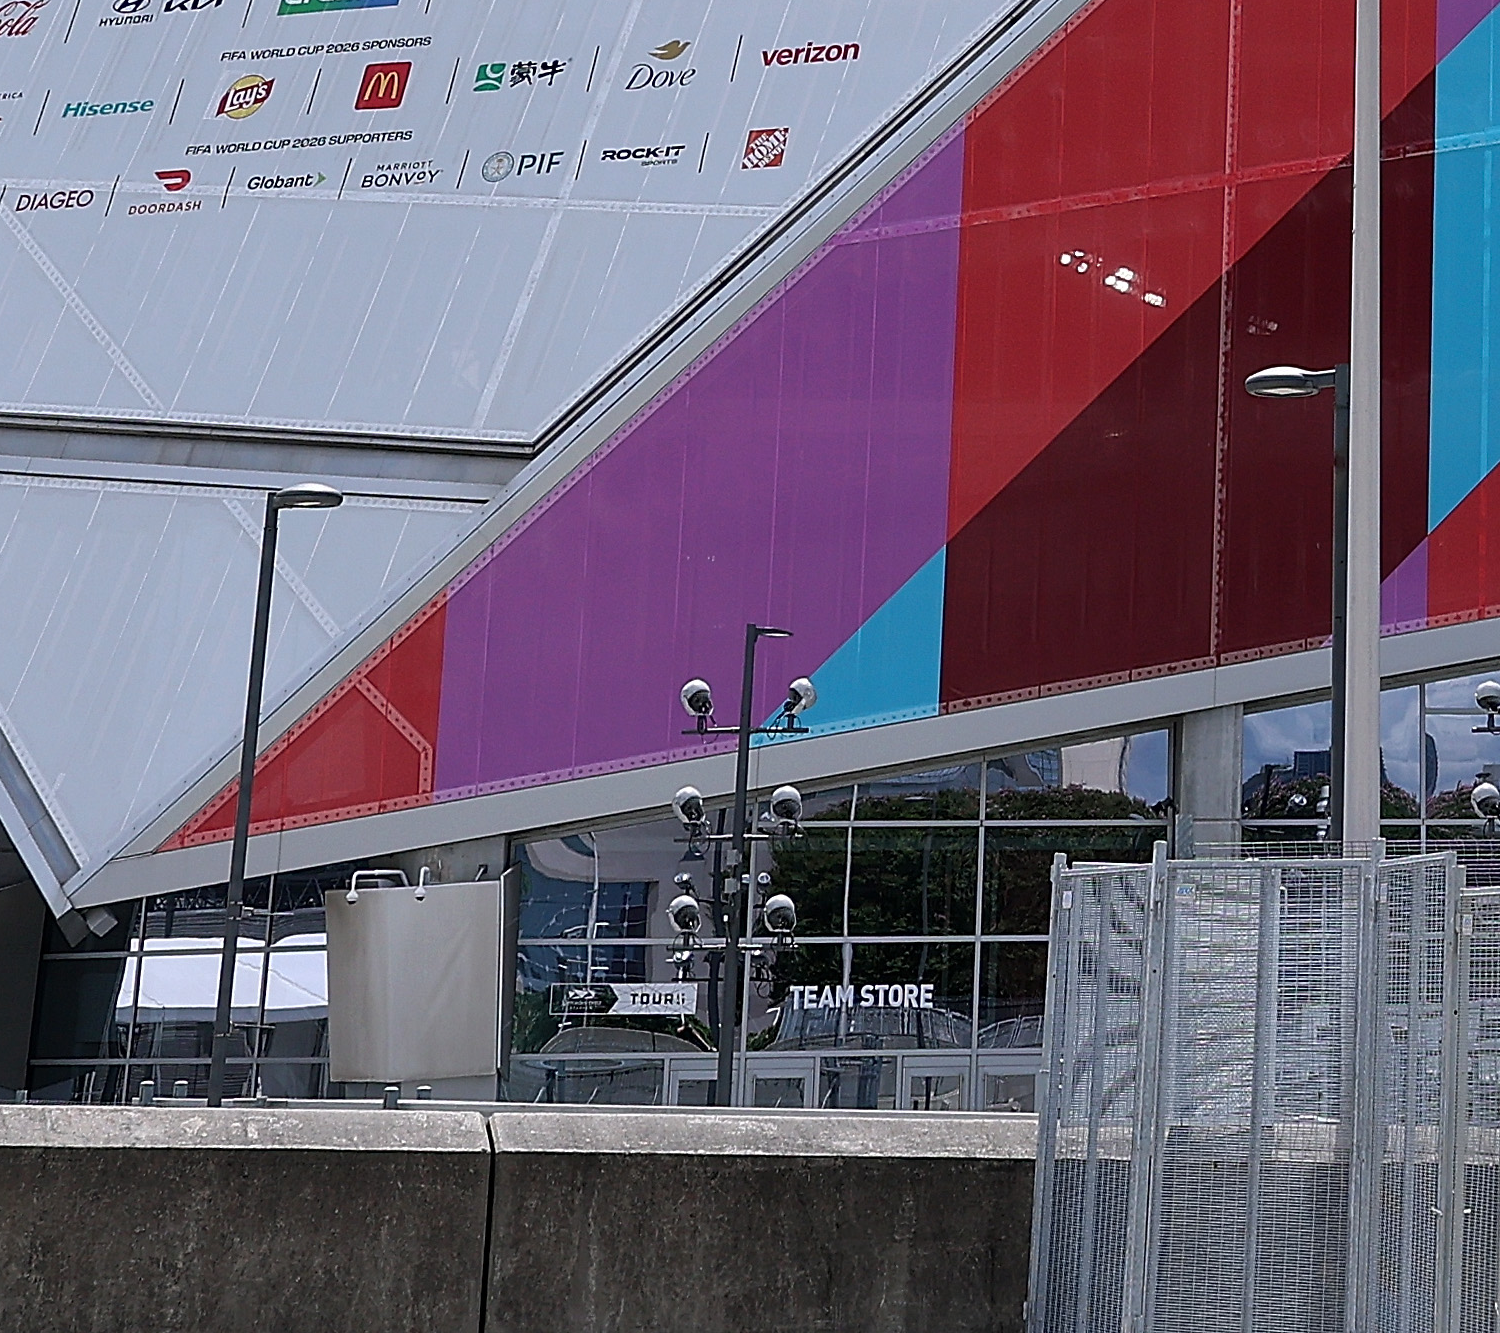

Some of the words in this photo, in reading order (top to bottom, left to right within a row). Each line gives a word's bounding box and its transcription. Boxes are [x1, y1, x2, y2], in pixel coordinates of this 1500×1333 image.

[99, 14, 154, 27] HYUNDAI
[220, 51, 247, 62] FIFA
[249, 46, 296, 60] WORLD
[297, 44, 325, 55] CUP
[326, 42, 360, 54] 2026
[361, 36, 432, 51] SPONSORS
[762, 41, 860, 66] verizon
[509, 59, 568, 87] 蒙牛
[625, 63, 697, 90] Dove
[61, 99, 155, 118] Hisense
[223, 82, 268, 112] Lay's
[185, 145, 212, 156] FIFA
[215, 141, 262, 154] WORLD
[263, 139, 290, 150] CUP
[292, 136, 326, 148] 2026
[328, 131, 413, 146] SUPPORTERS
[601, 145, 686, 161] ROCK-IT
[742, 128, 787, 169] HOME
[376, 160, 434, 171] MARRIOTT
[516, 151, 565, 176] PIF
[247, 173, 315, 190] Globant
[361, 170, 441, 188] BONVOY
[14, 189, 94, 213] DIAGEO
[127, 200, 202, 216] DOORDASH
[790, 985, 854, 1010] TEAM
[860, 983, 934, 1008] STORE
